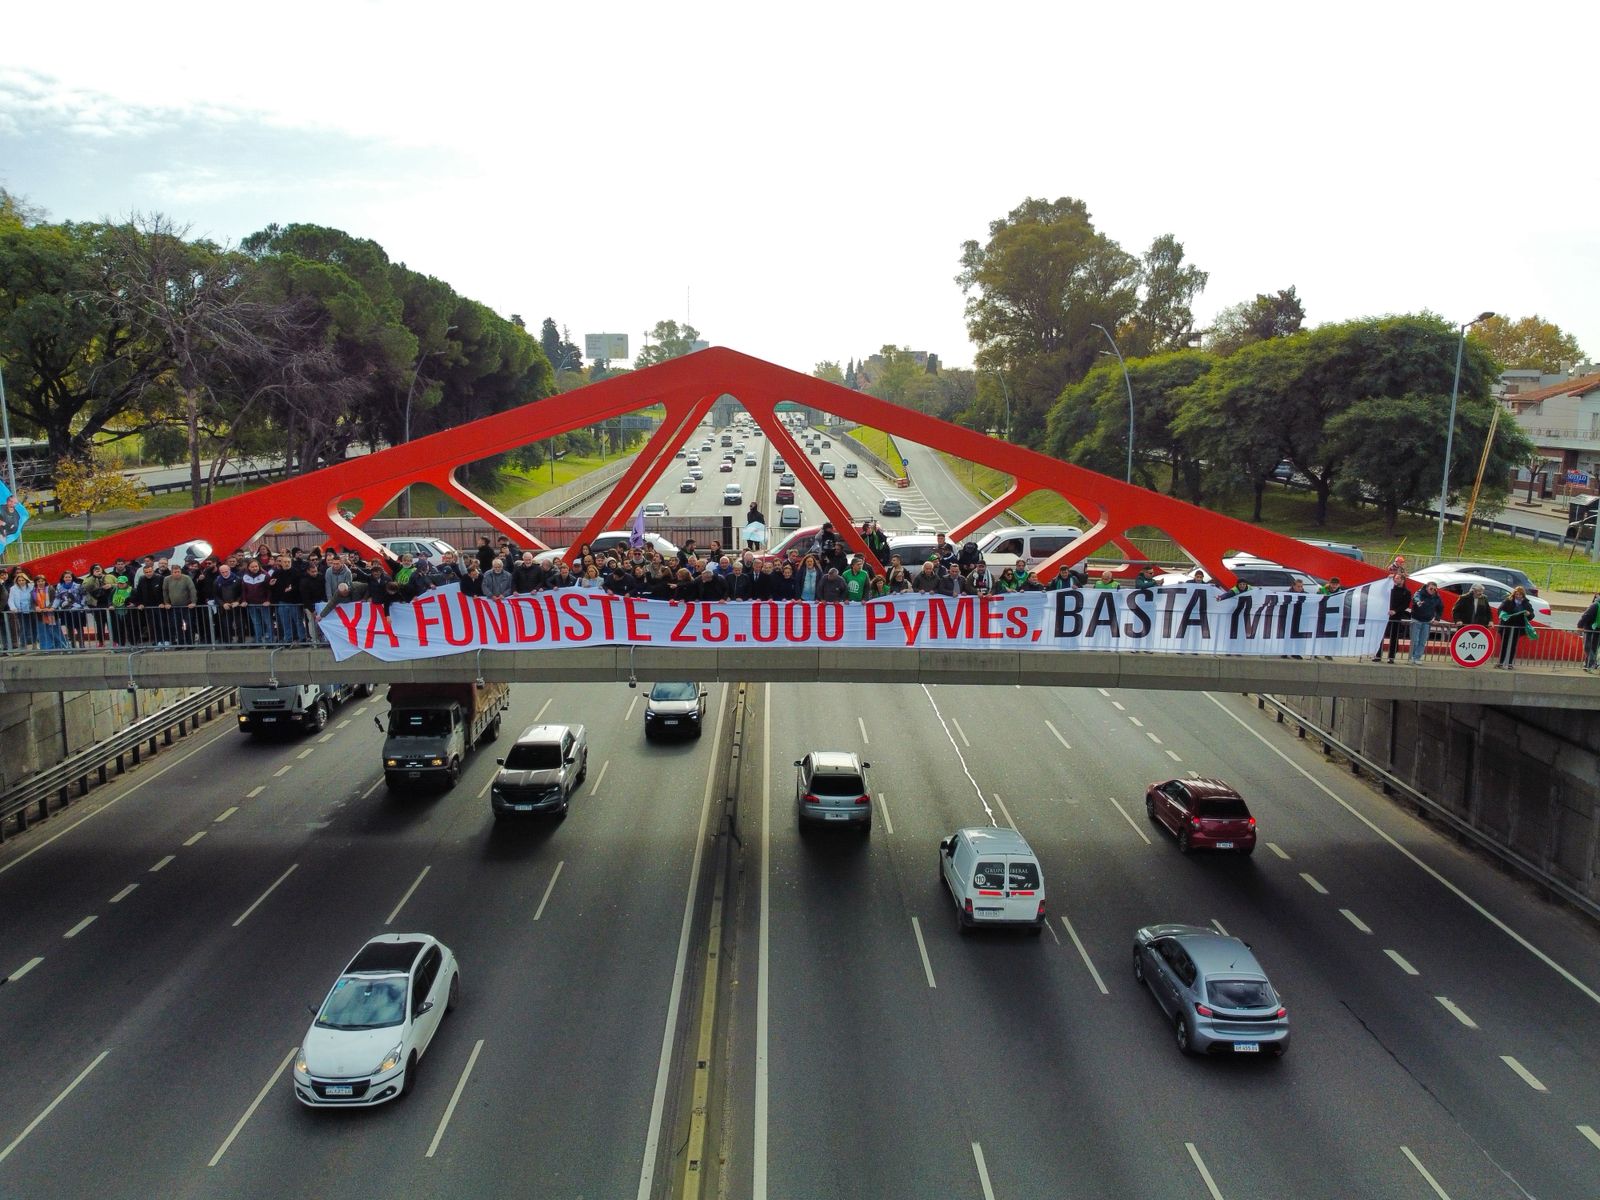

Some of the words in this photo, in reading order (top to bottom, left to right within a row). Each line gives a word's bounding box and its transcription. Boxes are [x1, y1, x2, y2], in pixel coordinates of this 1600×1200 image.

[335, 601, 400, 649] YA
[413, 591, 652, 647] FUNDISTE
[669, 600, 844, 642] 25.000
[866, 595, 1042, 646] PyMEs,
[1054, 587, 1210, 640] BASTA
[1229, 584, 1371, 640] MILEI!
